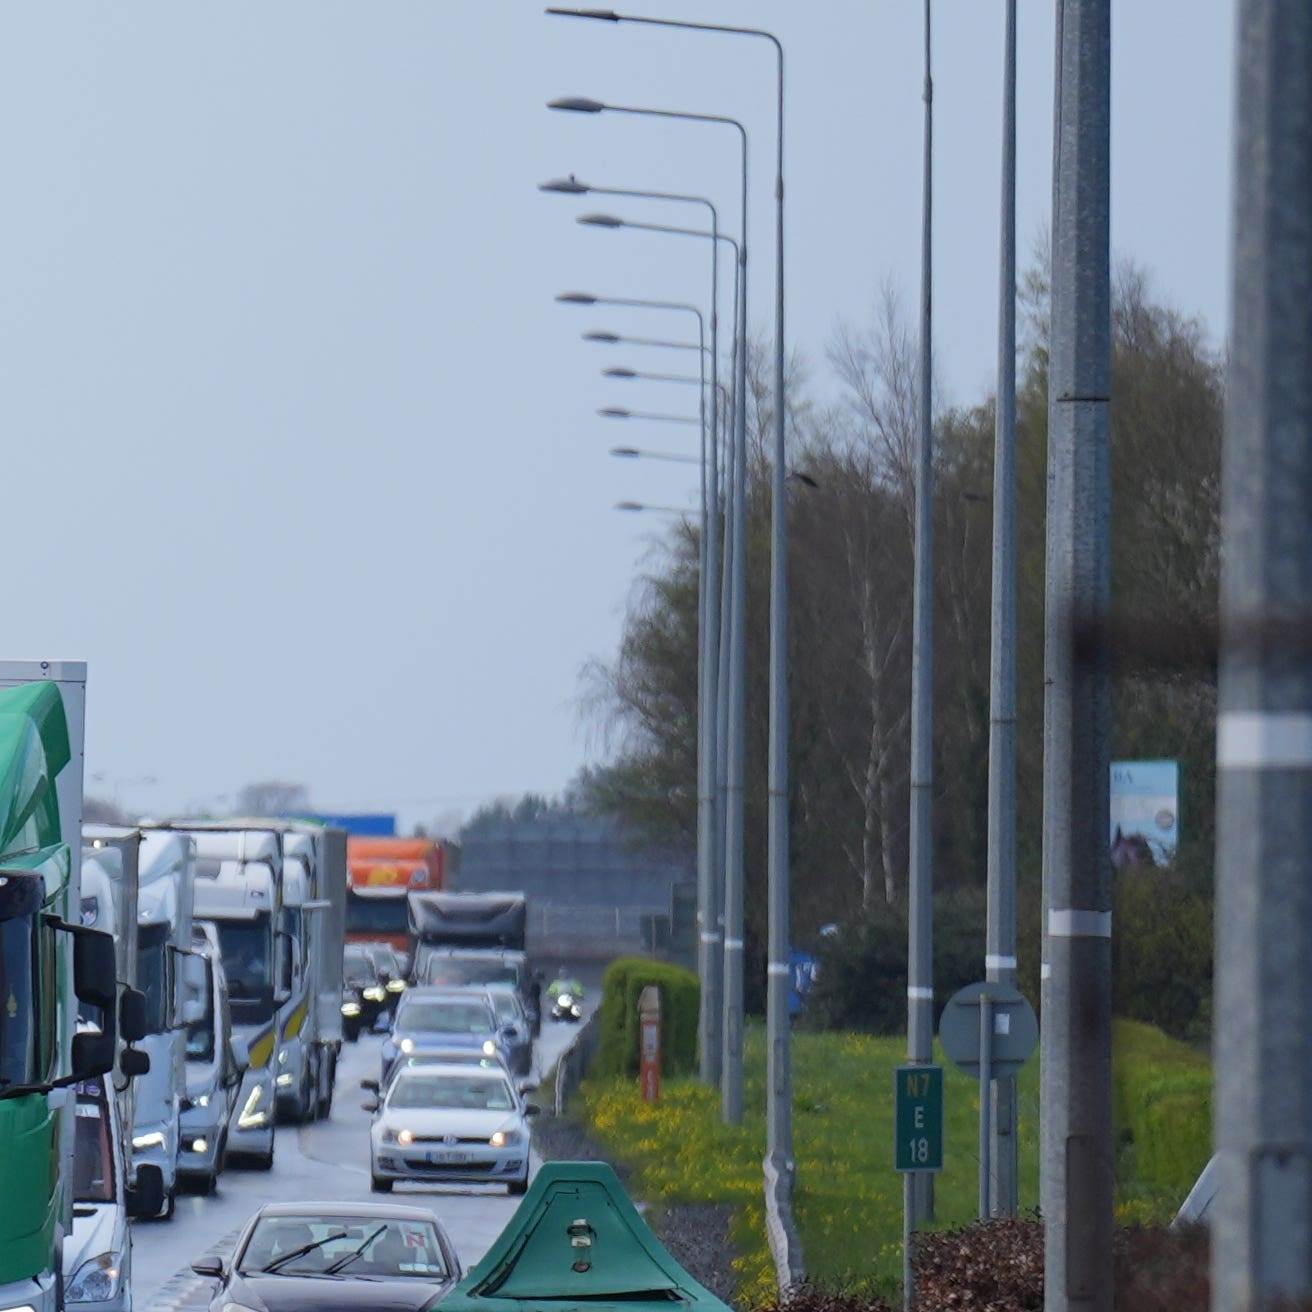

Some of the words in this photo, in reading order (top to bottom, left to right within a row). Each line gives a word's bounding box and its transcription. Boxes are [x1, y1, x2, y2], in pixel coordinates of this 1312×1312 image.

[906, 1071, 930, 1097] N7
[914, 1105, 925, 1129] E
[909, 1137, 929, 1163] 18
